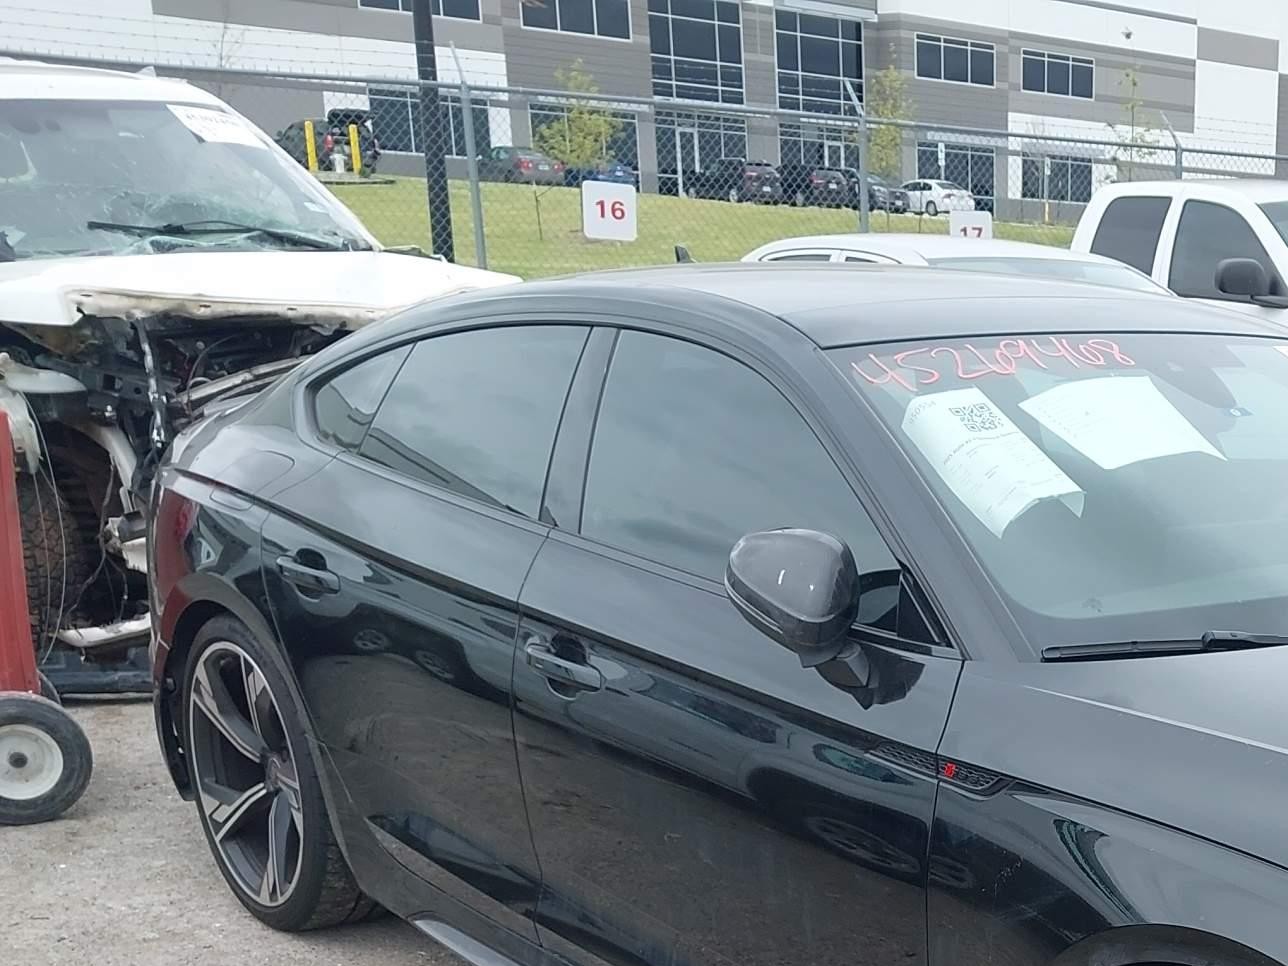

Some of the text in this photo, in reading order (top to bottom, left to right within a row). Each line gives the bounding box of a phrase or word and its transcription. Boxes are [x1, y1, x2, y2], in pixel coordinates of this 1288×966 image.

[595, 199, 625, 220] 16
[960, 226, 983, 238] 17
[850, 336, 1136, 392] 45269468
